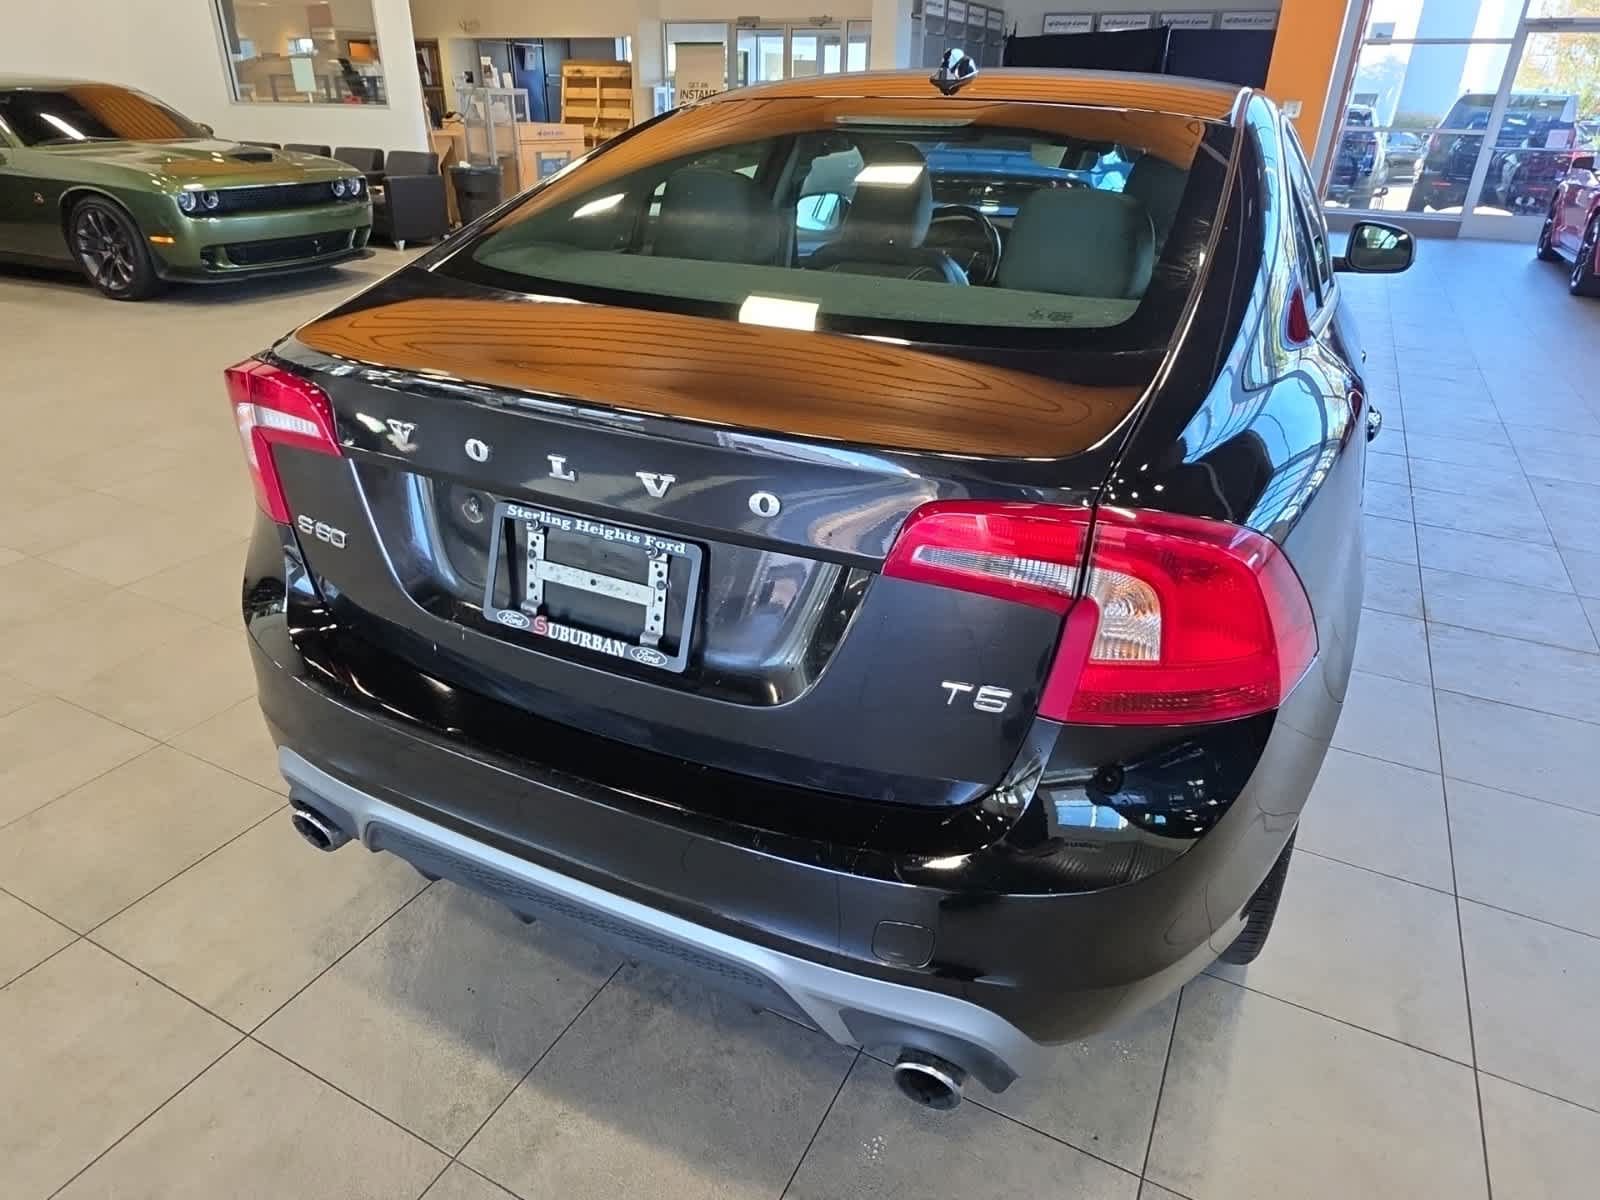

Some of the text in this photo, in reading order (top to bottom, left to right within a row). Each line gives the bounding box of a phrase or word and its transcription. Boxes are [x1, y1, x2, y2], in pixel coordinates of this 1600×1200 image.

[386, 418, 781, 518] VOLVO
[298, 514, 346, 549] S60
[507, 504, 687, 554] Sterling Heights Ford
[534, 615, 627, 658] SUBURBAN
[941, 680, 1013, 713] T5
